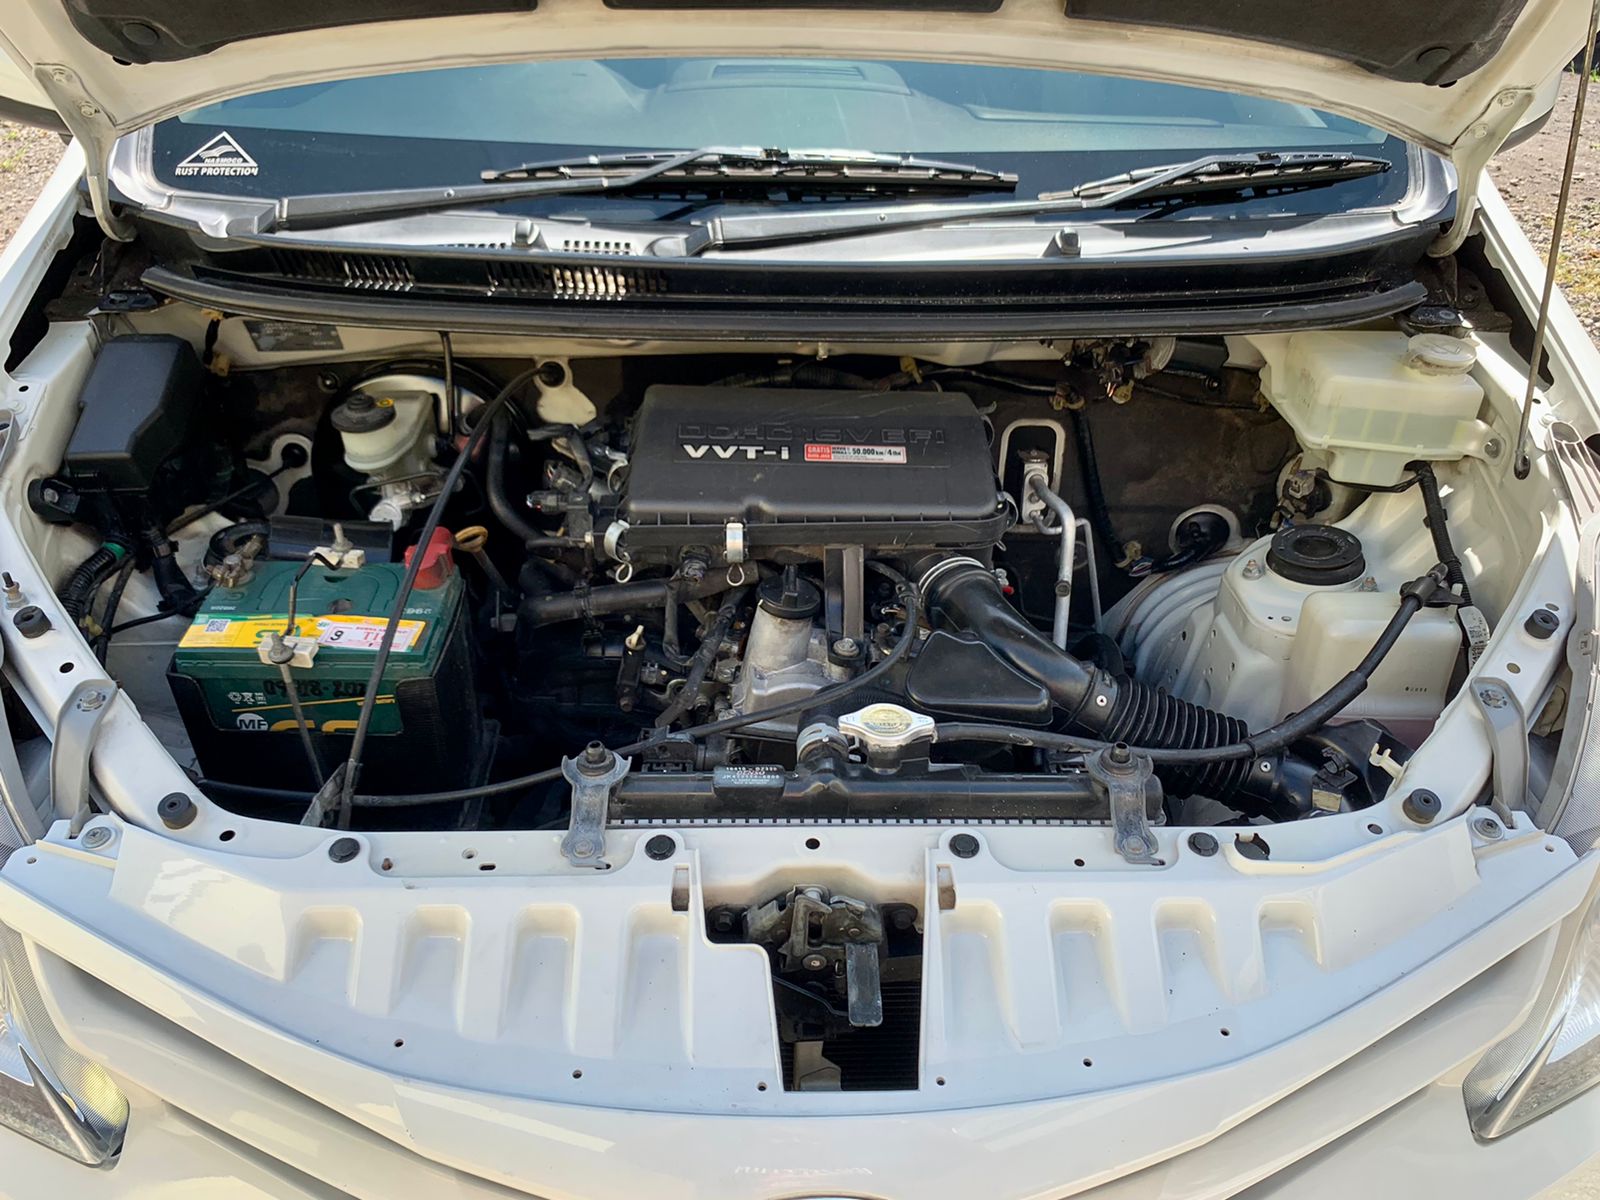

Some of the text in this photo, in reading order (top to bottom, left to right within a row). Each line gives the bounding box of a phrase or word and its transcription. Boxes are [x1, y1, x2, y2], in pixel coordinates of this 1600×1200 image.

[175, 167, 258, 176] RUST PROTECTION
[678, 423, 792, 440] DOHC
[239, 719, 268, 731] MF
